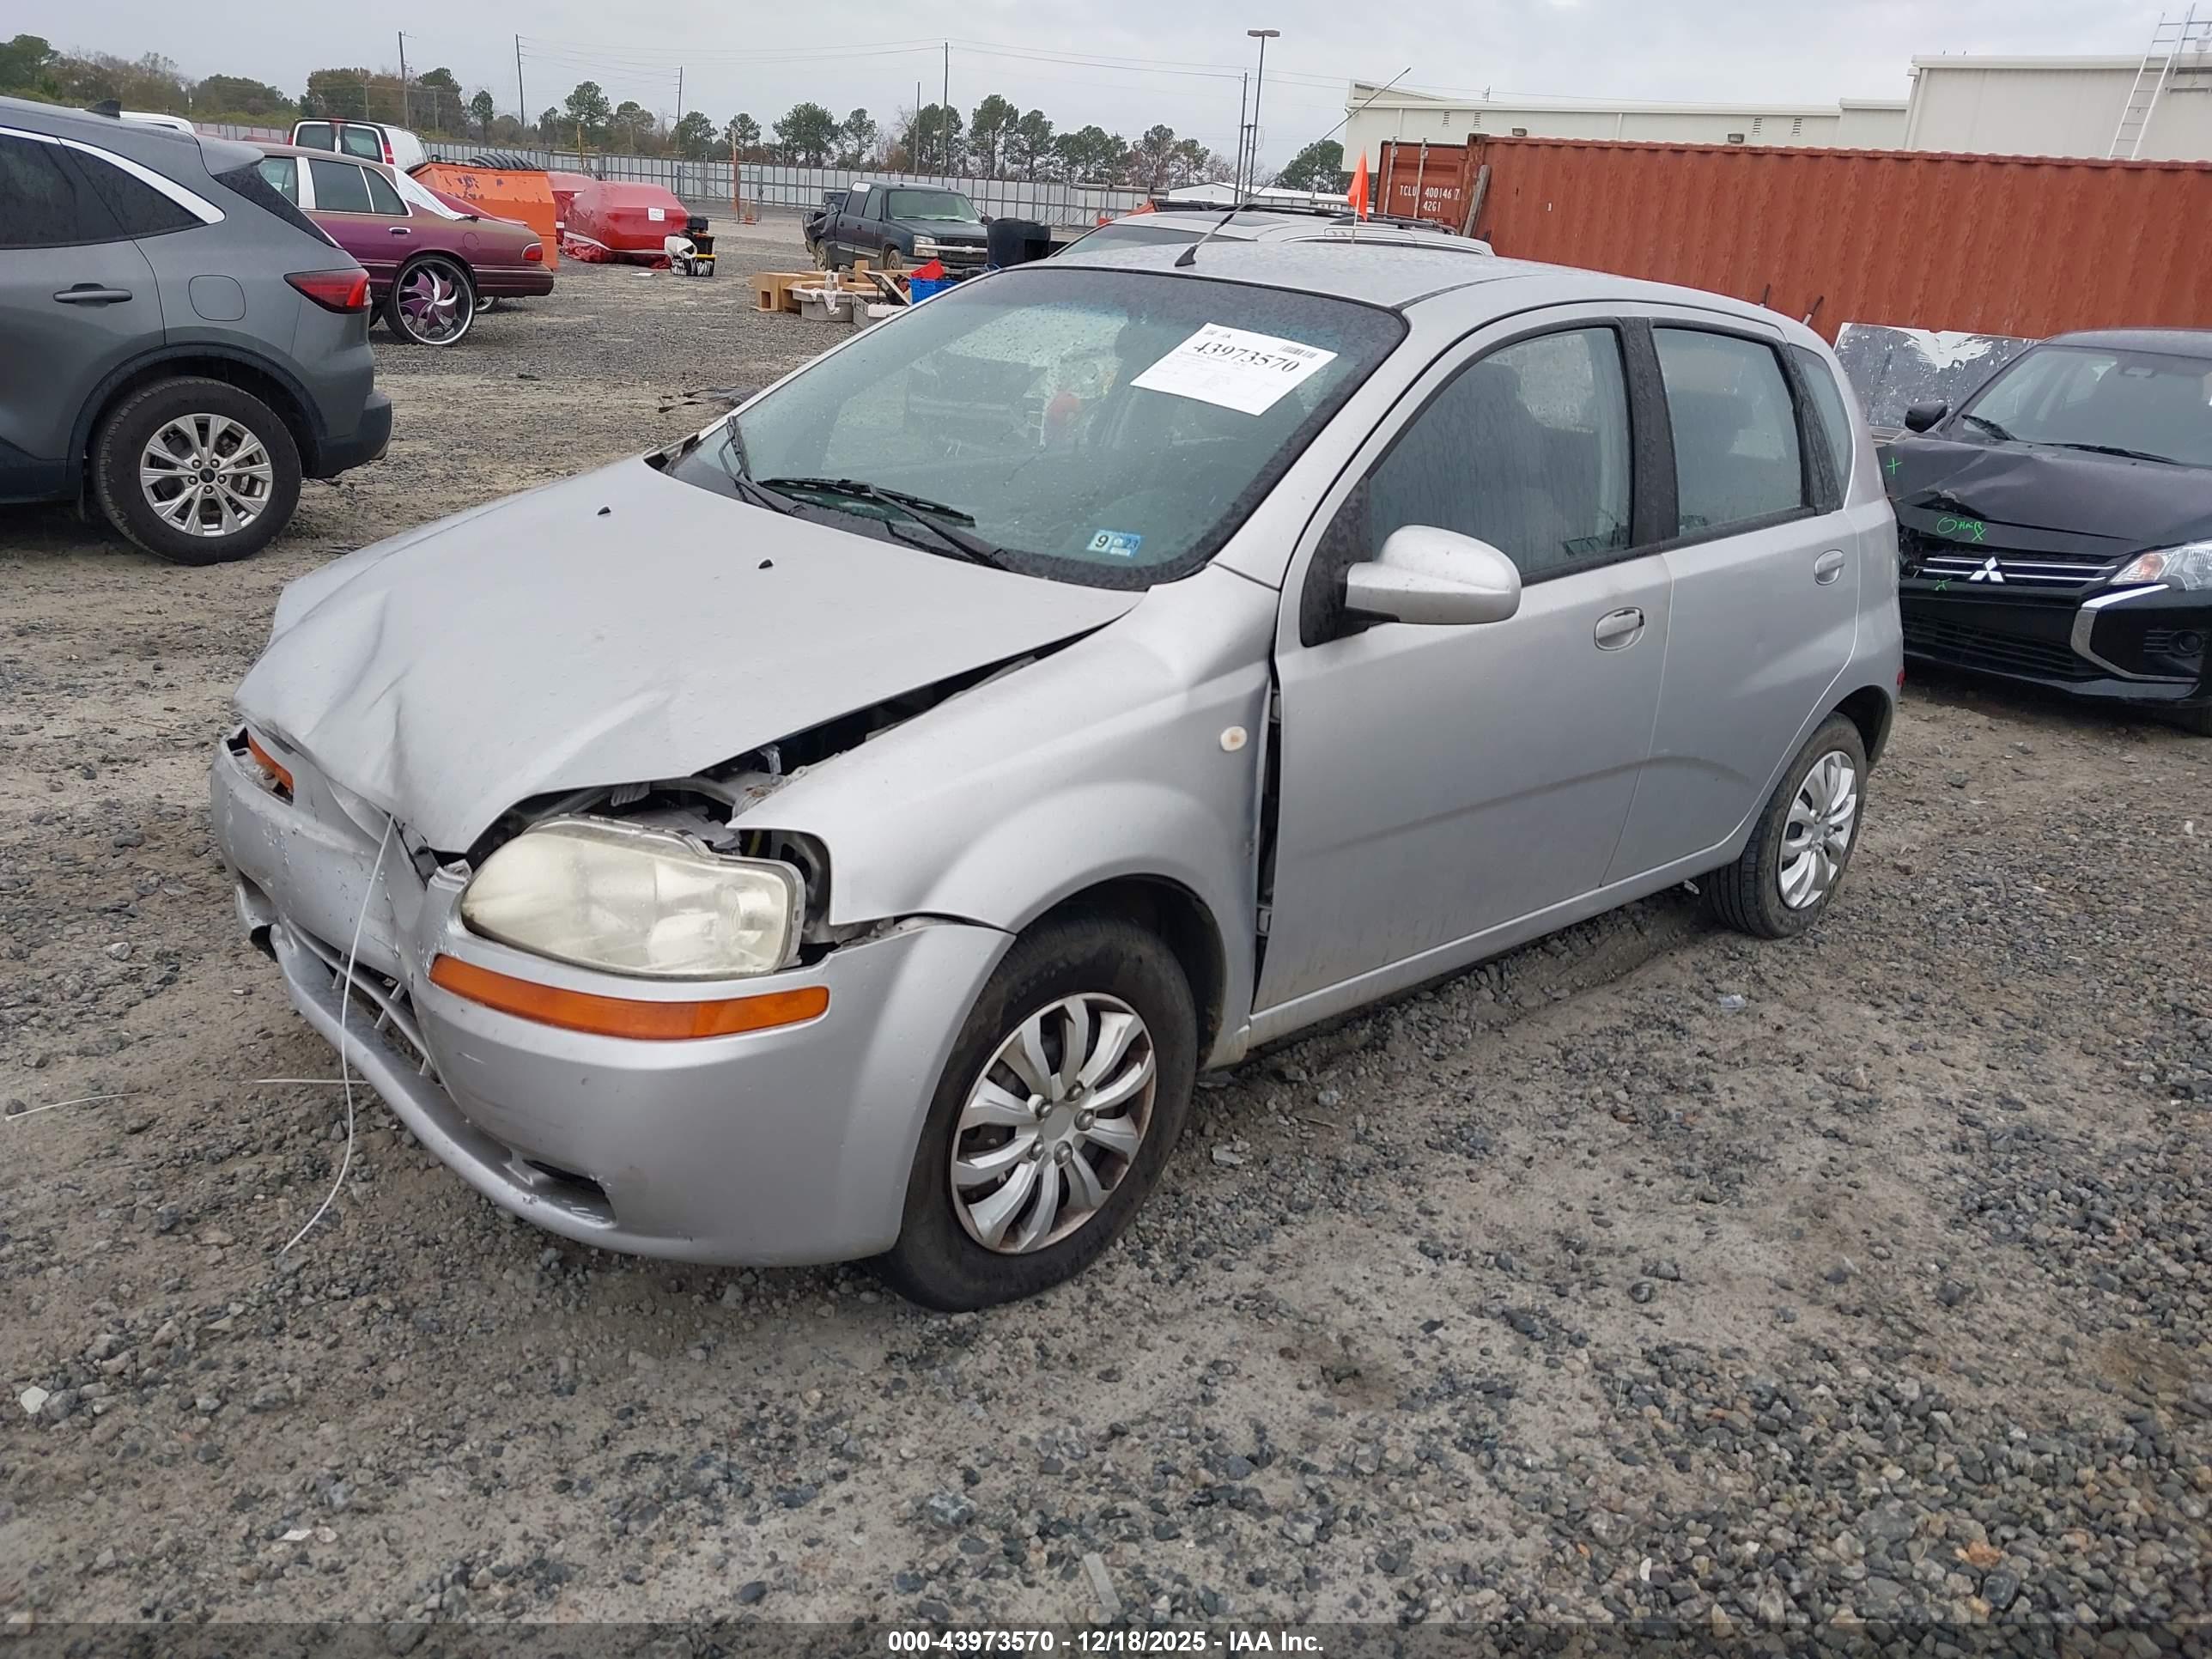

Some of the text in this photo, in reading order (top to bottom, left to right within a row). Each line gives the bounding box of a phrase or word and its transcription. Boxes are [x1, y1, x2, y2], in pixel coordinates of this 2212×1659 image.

[1425, 186, 1452, 199] 400146
[1455, 188, 1461, 200] 7
[1423, 200, 1442, 212] 42G1
[1194, 341, 1300, 372] 43973570
[1095, 534, 1109, 548] 9
